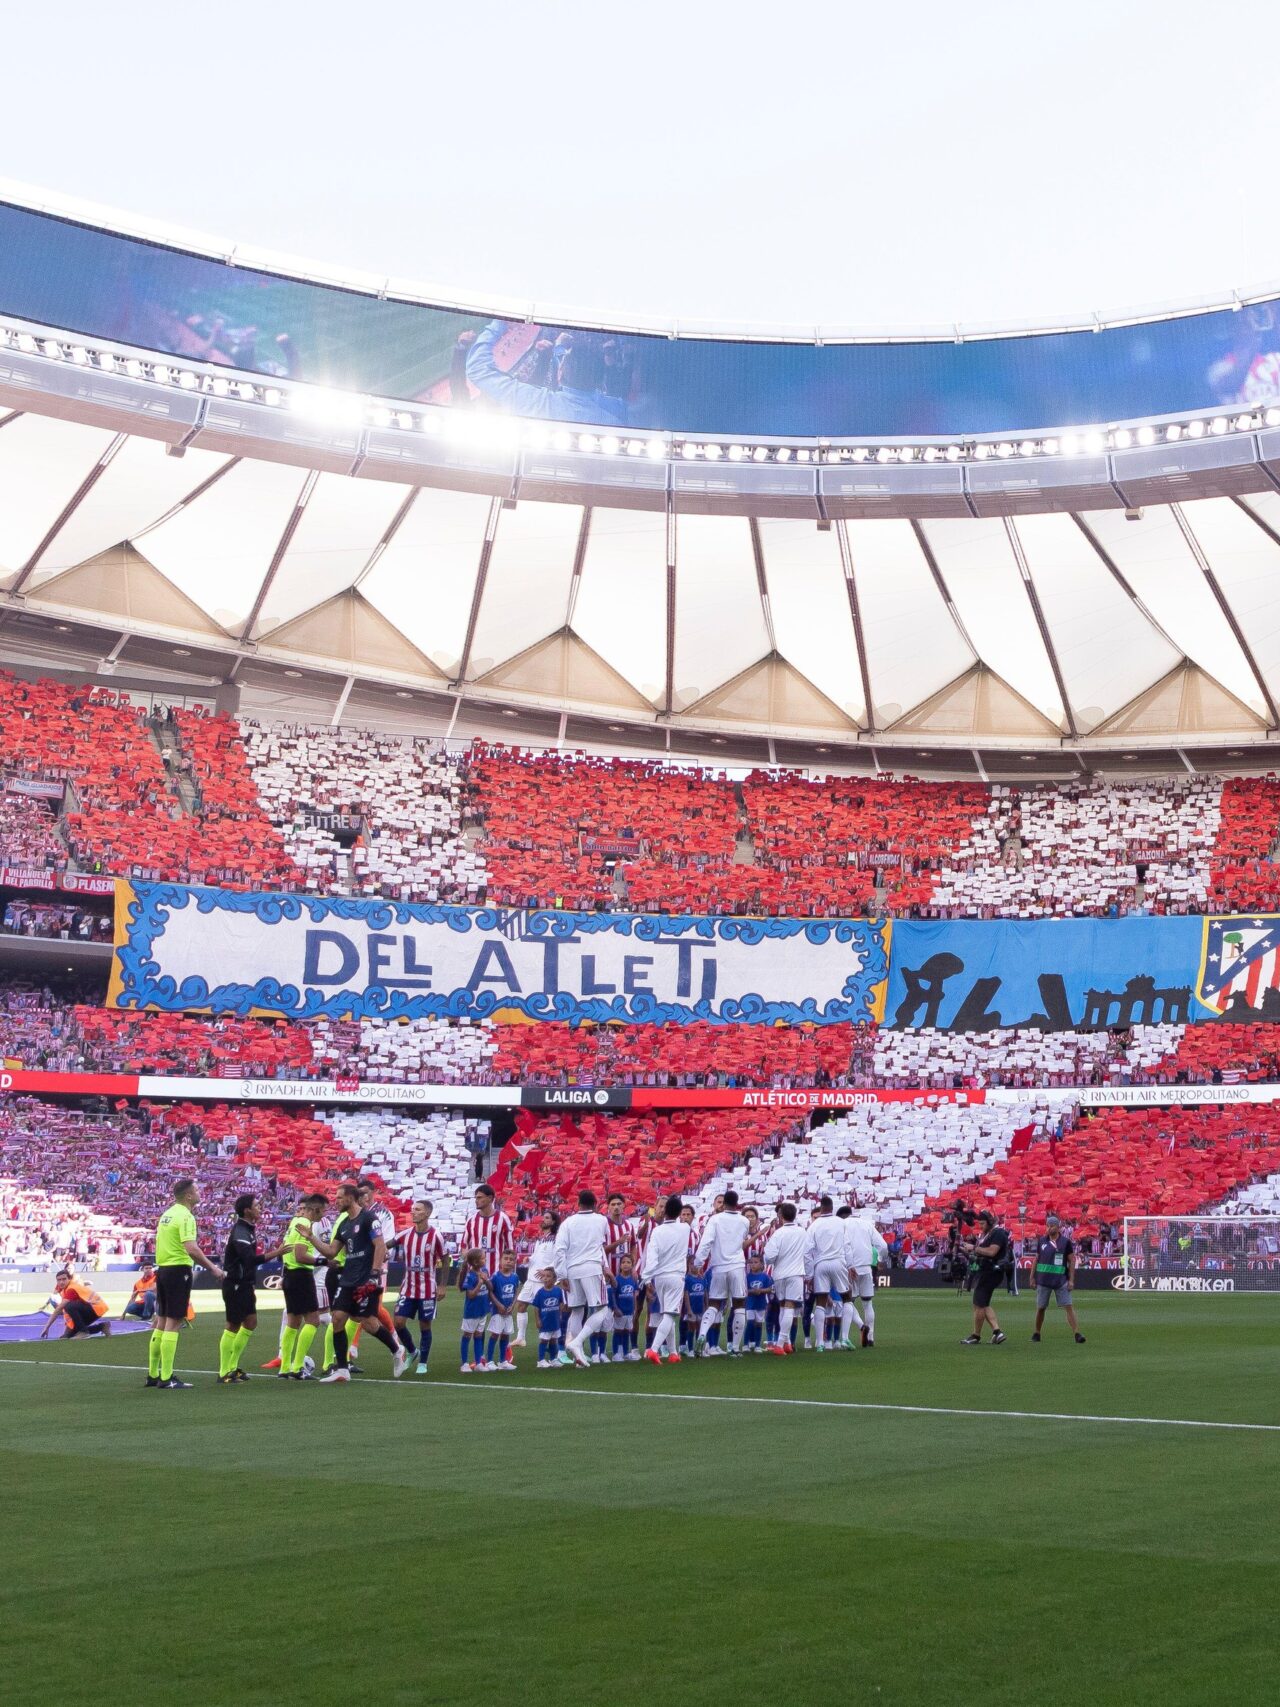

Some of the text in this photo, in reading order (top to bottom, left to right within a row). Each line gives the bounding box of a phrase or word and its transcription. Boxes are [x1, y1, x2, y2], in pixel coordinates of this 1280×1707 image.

[8, 867, 51, 879] VILLANUEVA
[5, 877, 18, 886] DEL
[303, 929, 718, 1000] DEL ATLETI
[256, 1084, 302, 1096] RIYADH
[307, 1086, 327, 1097] AIR
[545, 1090, 592, 1103] LALIGA
[1091, 1088, 1250, 1101] RIYADH AIR METROPOLITANO
[743, 1090, 878, 1106] ATLÉTICO DE MADRID
